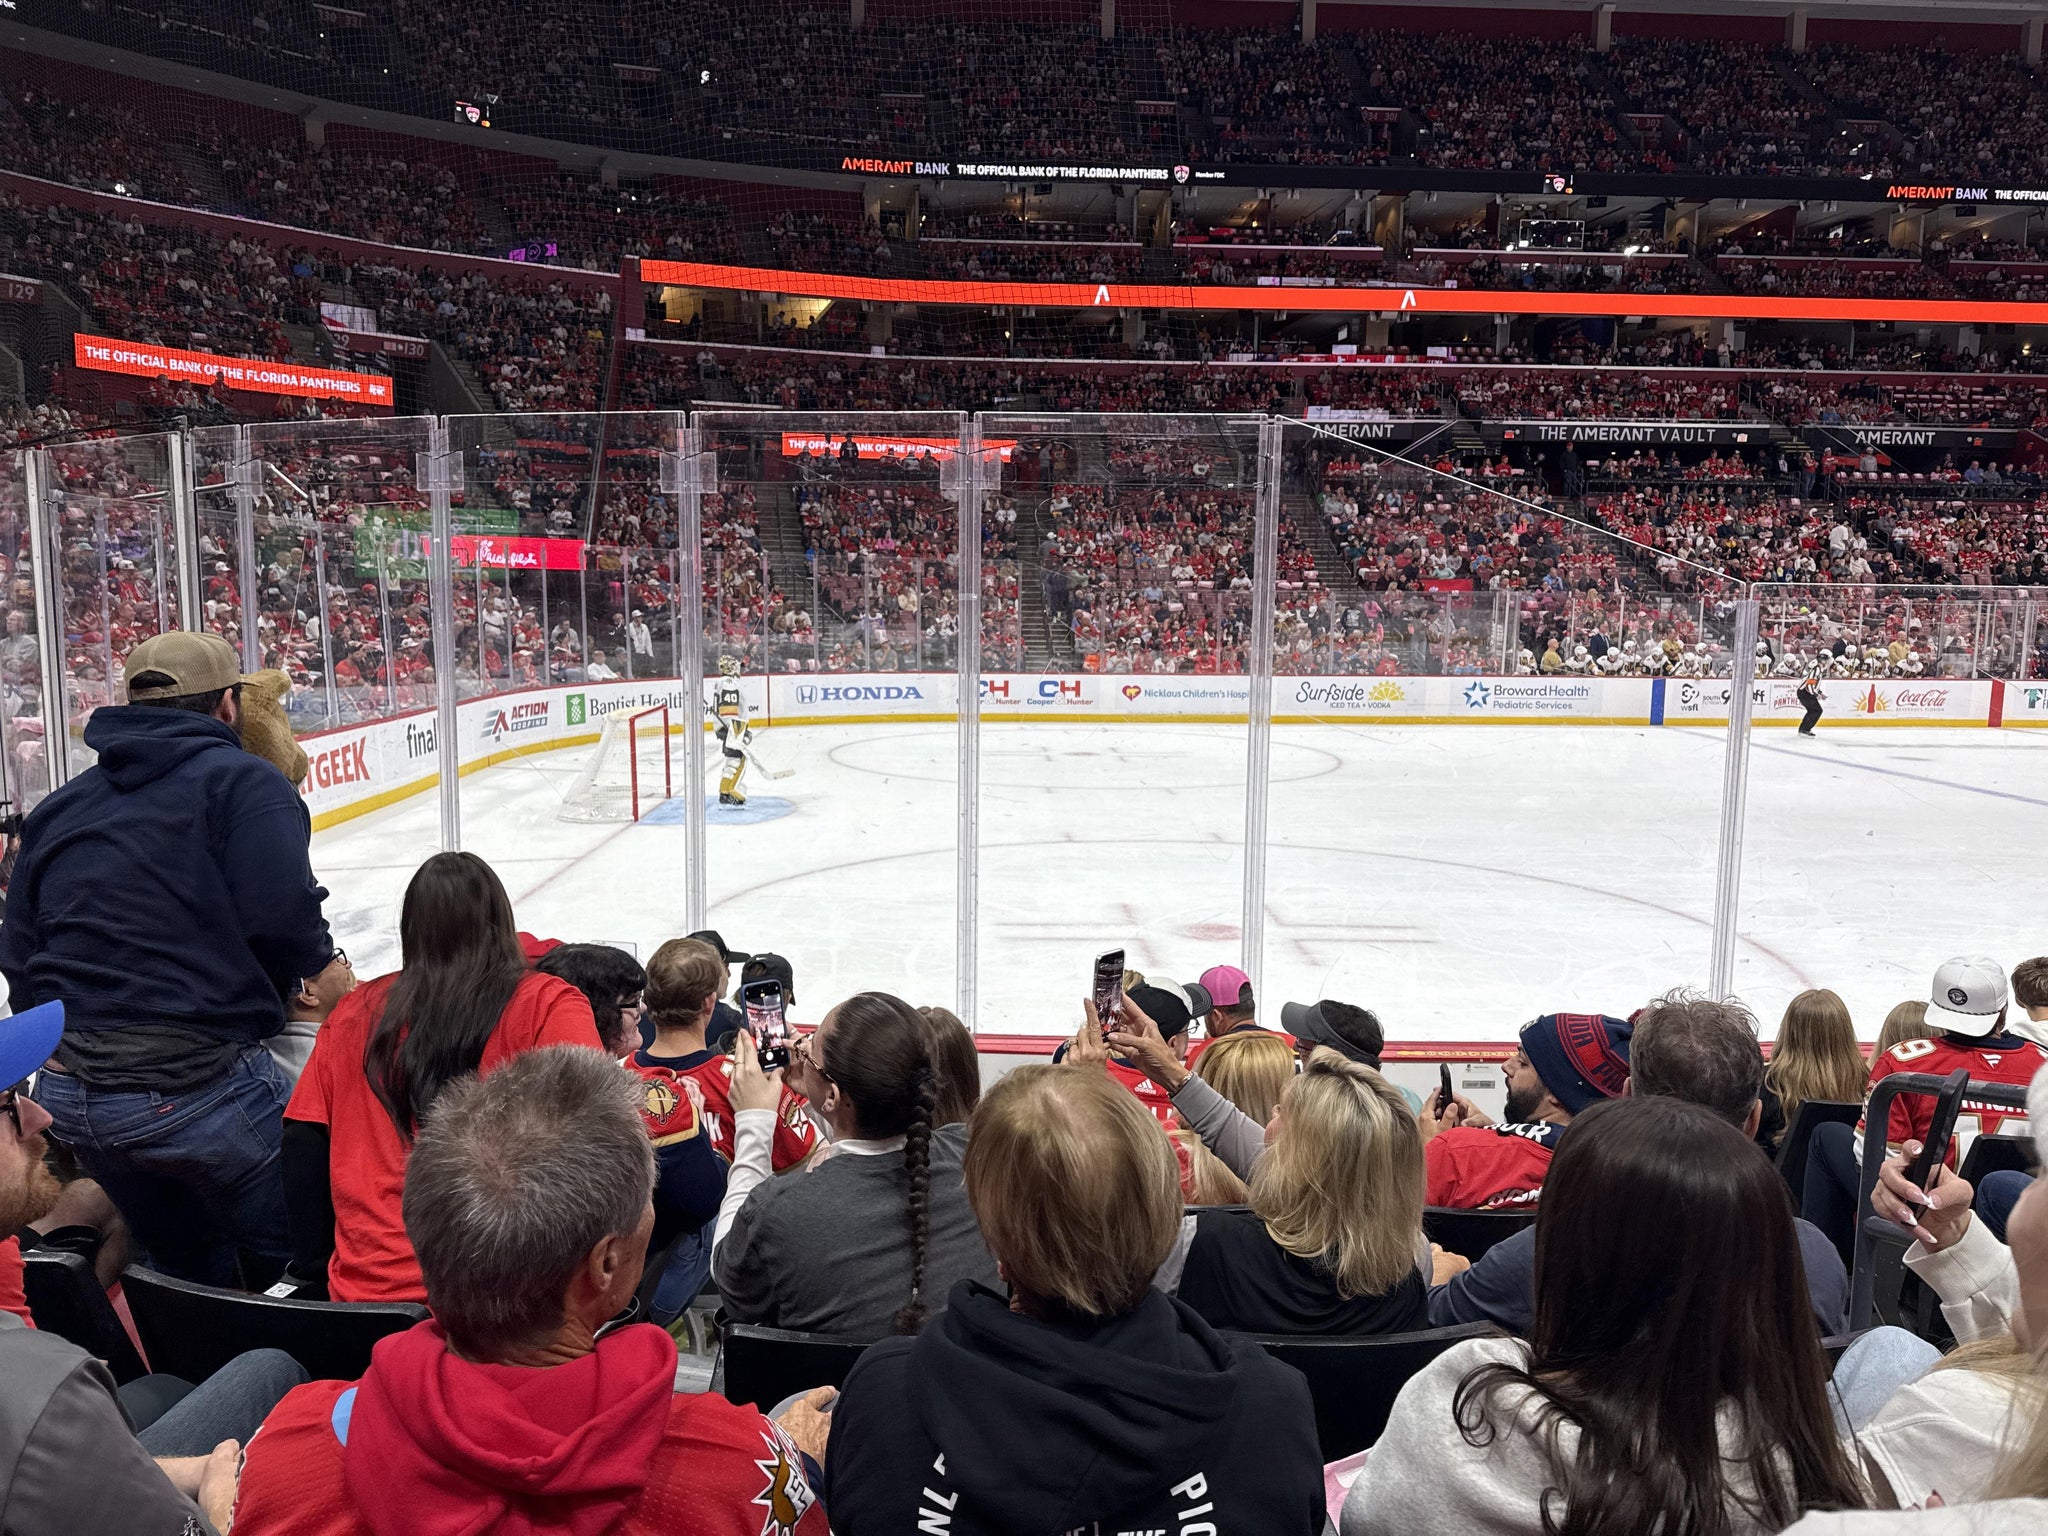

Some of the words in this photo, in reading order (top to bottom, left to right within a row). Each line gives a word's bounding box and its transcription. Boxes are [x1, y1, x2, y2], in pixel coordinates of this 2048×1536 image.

[842, 157, 913, 174] AMERANT
[915, 162, 950, 175] BANK
[957, 164, 976, 175] THE
[977, 165, 1018, 176] OFFICIAL
[1019, 166, 1045, 177] BANK
[1046, 167, 1059, 177] OF
[1060, 167, 1078, 178] THE
[1079, 167, 1119, 178] FLORIDA
[1120, 168, 1168, 180] PANTHERS
[1887, 185, 1954, 199] AMERANT
[1955, 188, 1988, 200] BANK
[1995, 190, 2013, 200] THE
[9, 283, 35, 300] 129
[404, 342, 424, 356] 130
[85, 345, 110, 360] THE
[113, 350, 167, 369] OFFICIAL
[169, 358, 201, 374] BANK
[204, 363, 218, 376] OF
[221, 366, 243, 380] THE
[246, 369, 298, 387] FLORIDA
[300, 376, 361, 394] PANTHERS
[1312, 423, 1394, 439] AMERANT
[1539, 426, 1567, 440] THE
[1572, 427, 1654, 441] AMERANT
[1660, 428, 1716, 442] VAULT
[1855, 430, 1936, 445] AMERANT
[875, 443, 888, 452] OF
[821, 687, 923, 701] HONDA
[1039, 680, 1081, 698] CH
[1144, 689, 1181, 698] Nicklaus
[1183, 689, 1225, 699] Children's
[1296, 681, 1364, 703] Surfside
[1494, 685, 1548, 697] Broward
[1549, 685, 1589, 697] Health
[724, 694, 737, 703] 40
[1027, 698, 1054, 707] Cooper
[1493, 700, 1532, 709] Pediatric
[1535, 701, 1573, 710] Services
[1896, 689, 1949, 707] Coca-Cola
[511, 702, 549, 719] ACTION
[1681, 704, 1699, 712] wsfl
[512, 717, 547, 732] ROOFING
